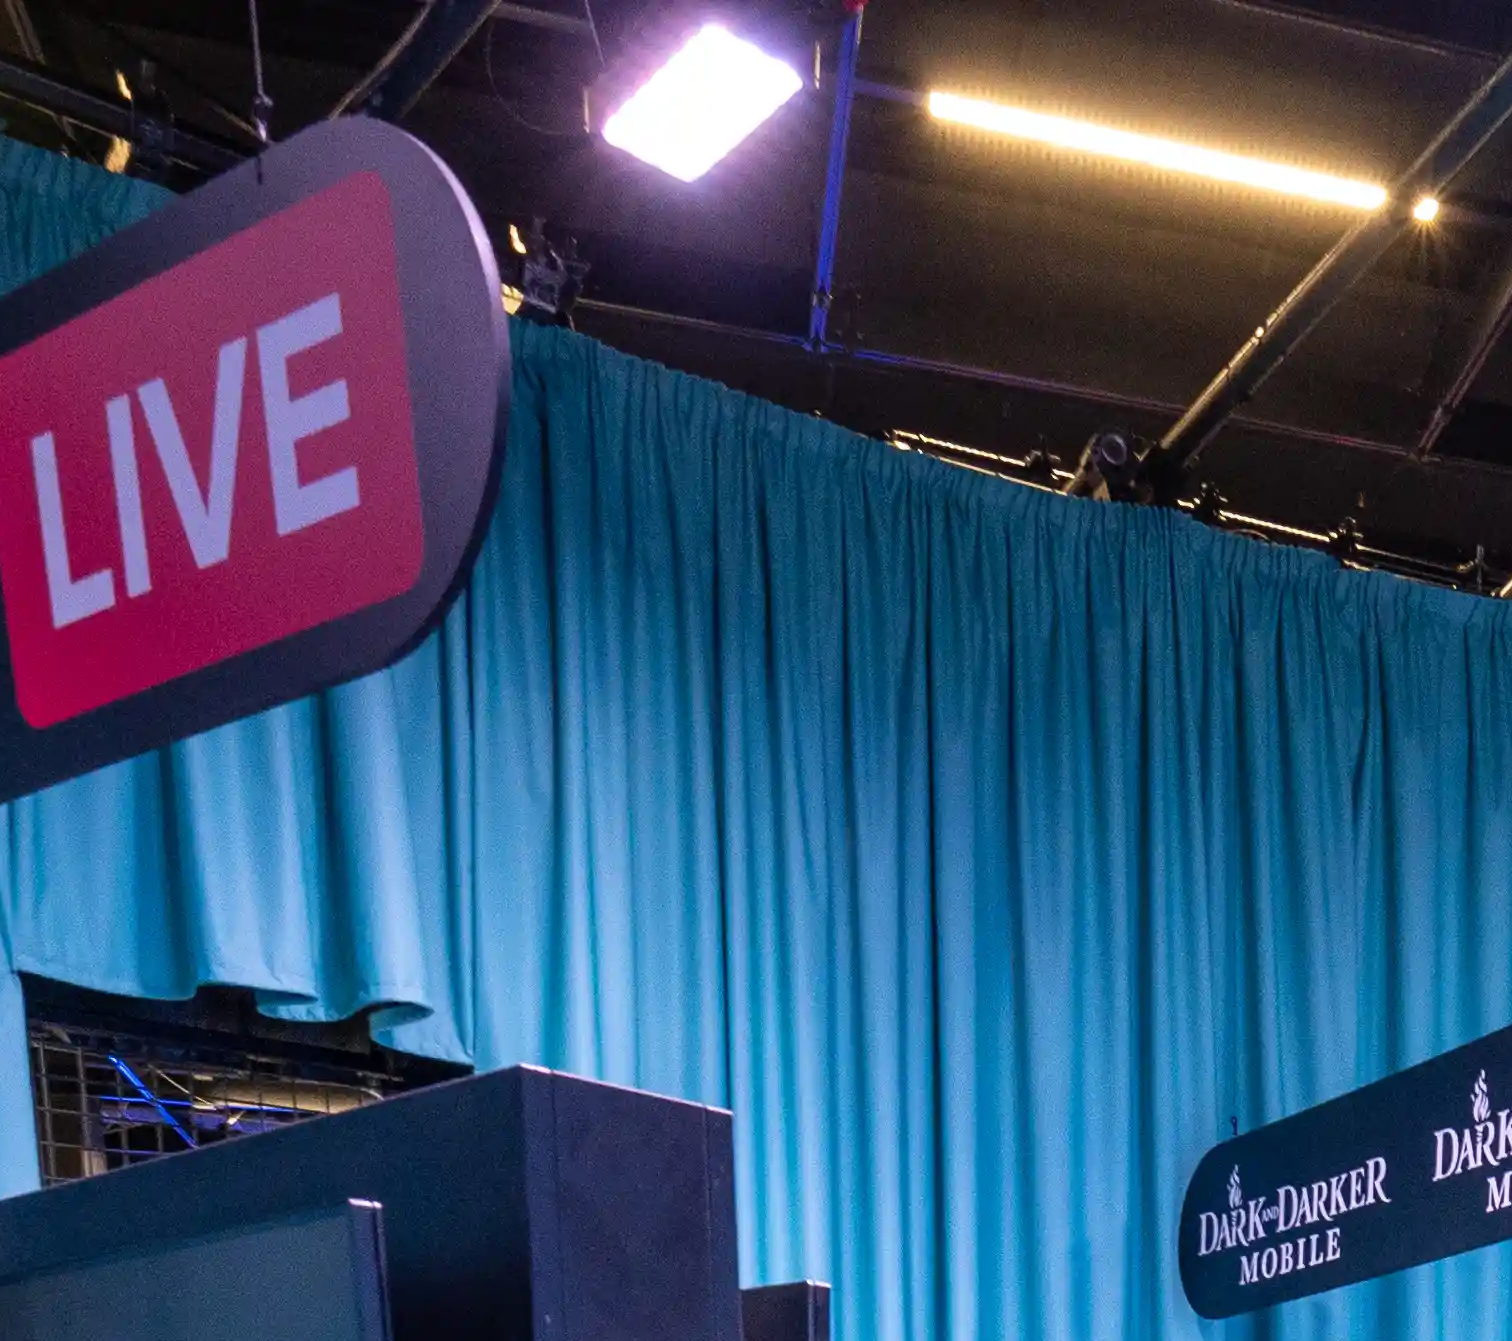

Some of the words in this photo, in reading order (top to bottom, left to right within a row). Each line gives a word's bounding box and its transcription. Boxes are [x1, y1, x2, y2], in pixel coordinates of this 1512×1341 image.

[31, 292, 361, 629] LIVE
[1198, 1196, 1267, 1257] DARK
[1276, 1156, 1392, 1234] DARKER
[1239, 1227, 1341, 1286] MOBILE
